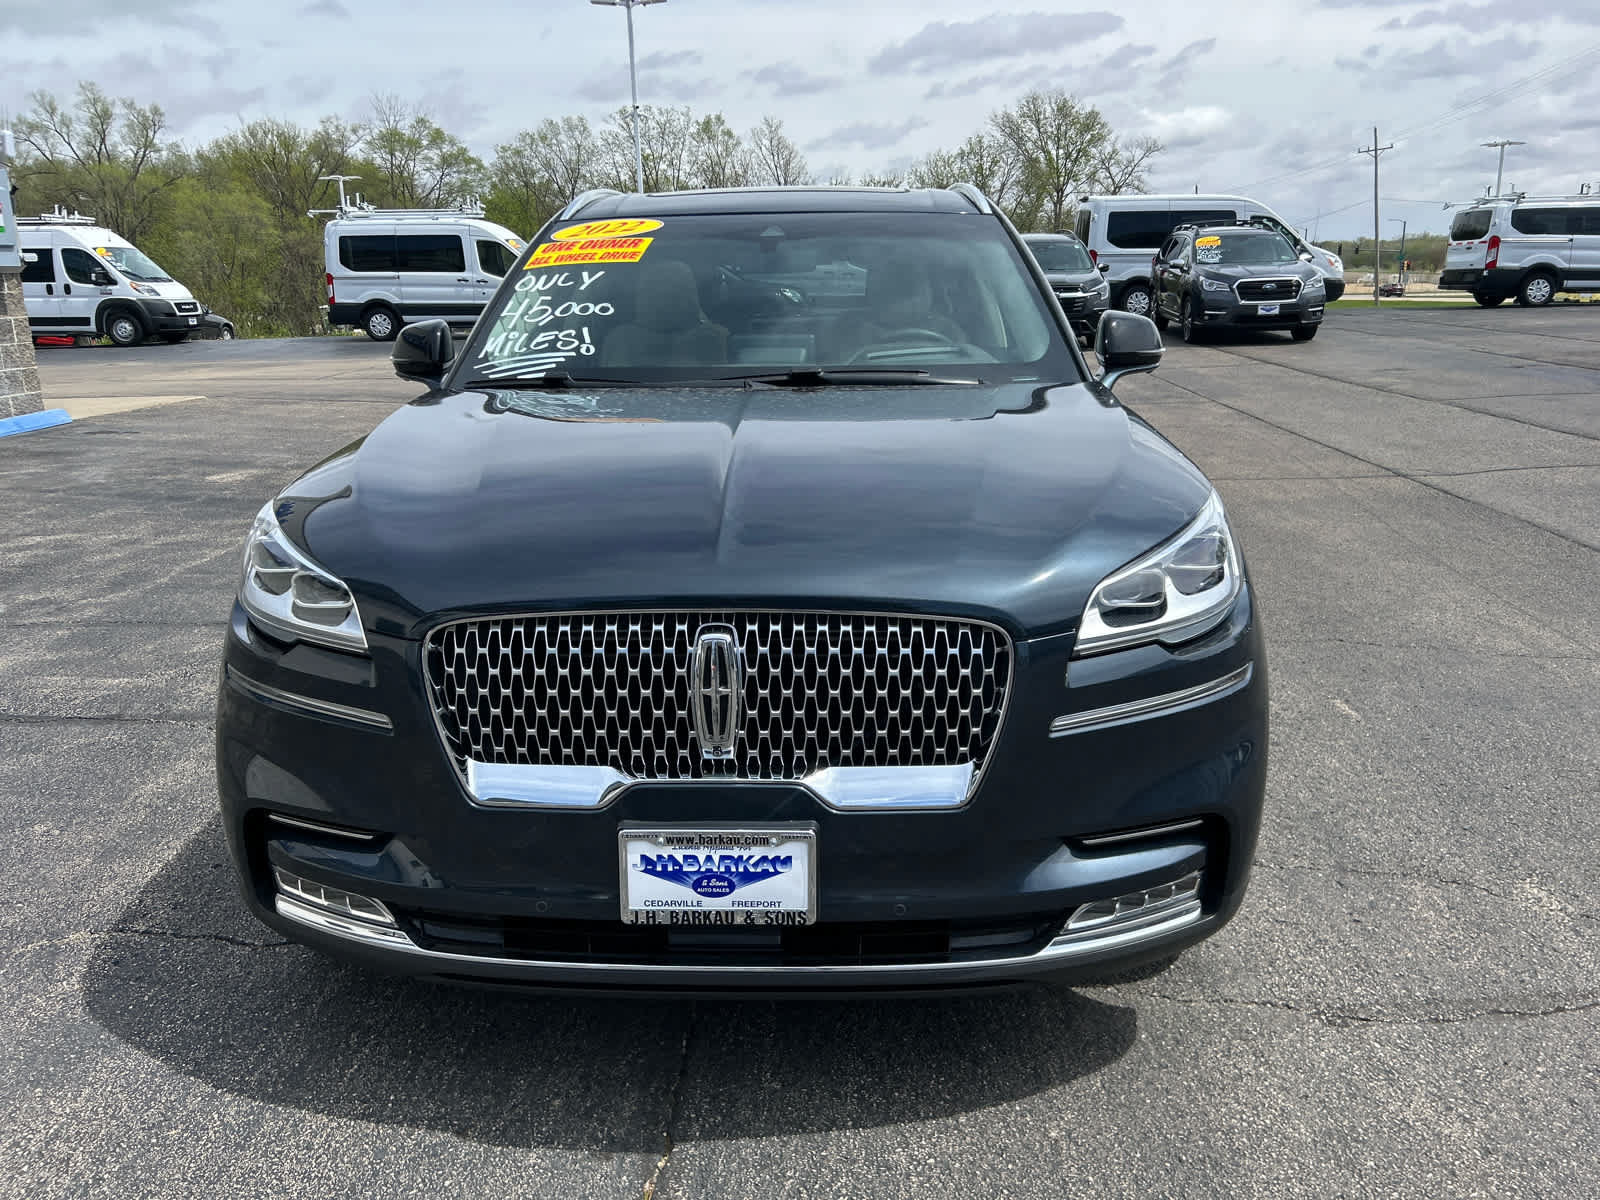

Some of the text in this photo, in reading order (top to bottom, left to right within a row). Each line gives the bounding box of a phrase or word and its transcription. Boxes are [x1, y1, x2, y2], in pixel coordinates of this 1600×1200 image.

[566, 220, 647, 238] 2022
[541, 238, 645, 255] ONE OWNER
[527, 251, 642, 268] ALL WHEEL DRIVE
[514, 270, 606, 293] ONLY
[501, 296, 615, 330] 45,000
[666, 833, 770, 847] www.barkau.com
[643, 899, 783, 908] CEDARVILLE FREEPORT
[670, 911, 735, 925] BARKAU
[744, 911, 757, 925] &
[765, 911, 807, 926] SONS
